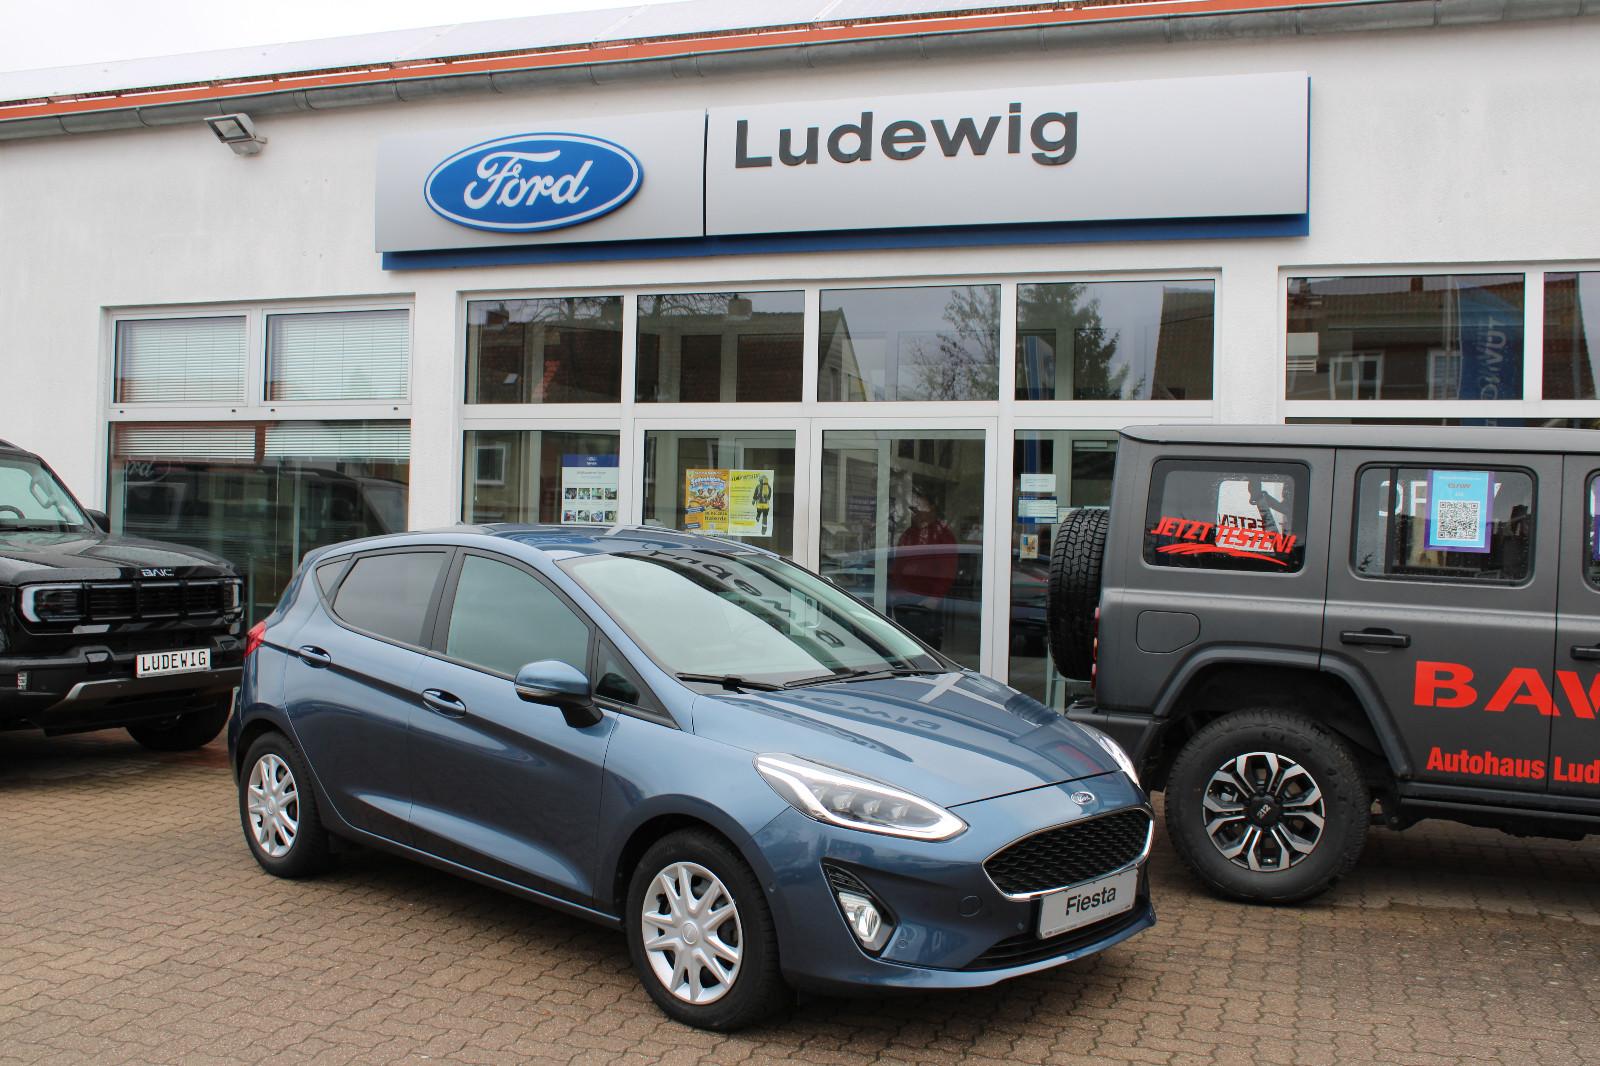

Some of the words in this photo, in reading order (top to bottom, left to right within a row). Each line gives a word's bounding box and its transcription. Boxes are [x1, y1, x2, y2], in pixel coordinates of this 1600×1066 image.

[735, 102, 1079, 169] Ludewig
[463, 150, 594, 210] Ford
[1151, 516, 1215, 542] JETZT
[1214, 524, 1297, 554] TESTEN!
[142, 651, 206, 672] LUDEWIG
[1426, 746, 1546, 779] Autohaus
[1065, 886, 1117, 916] Fiesta
